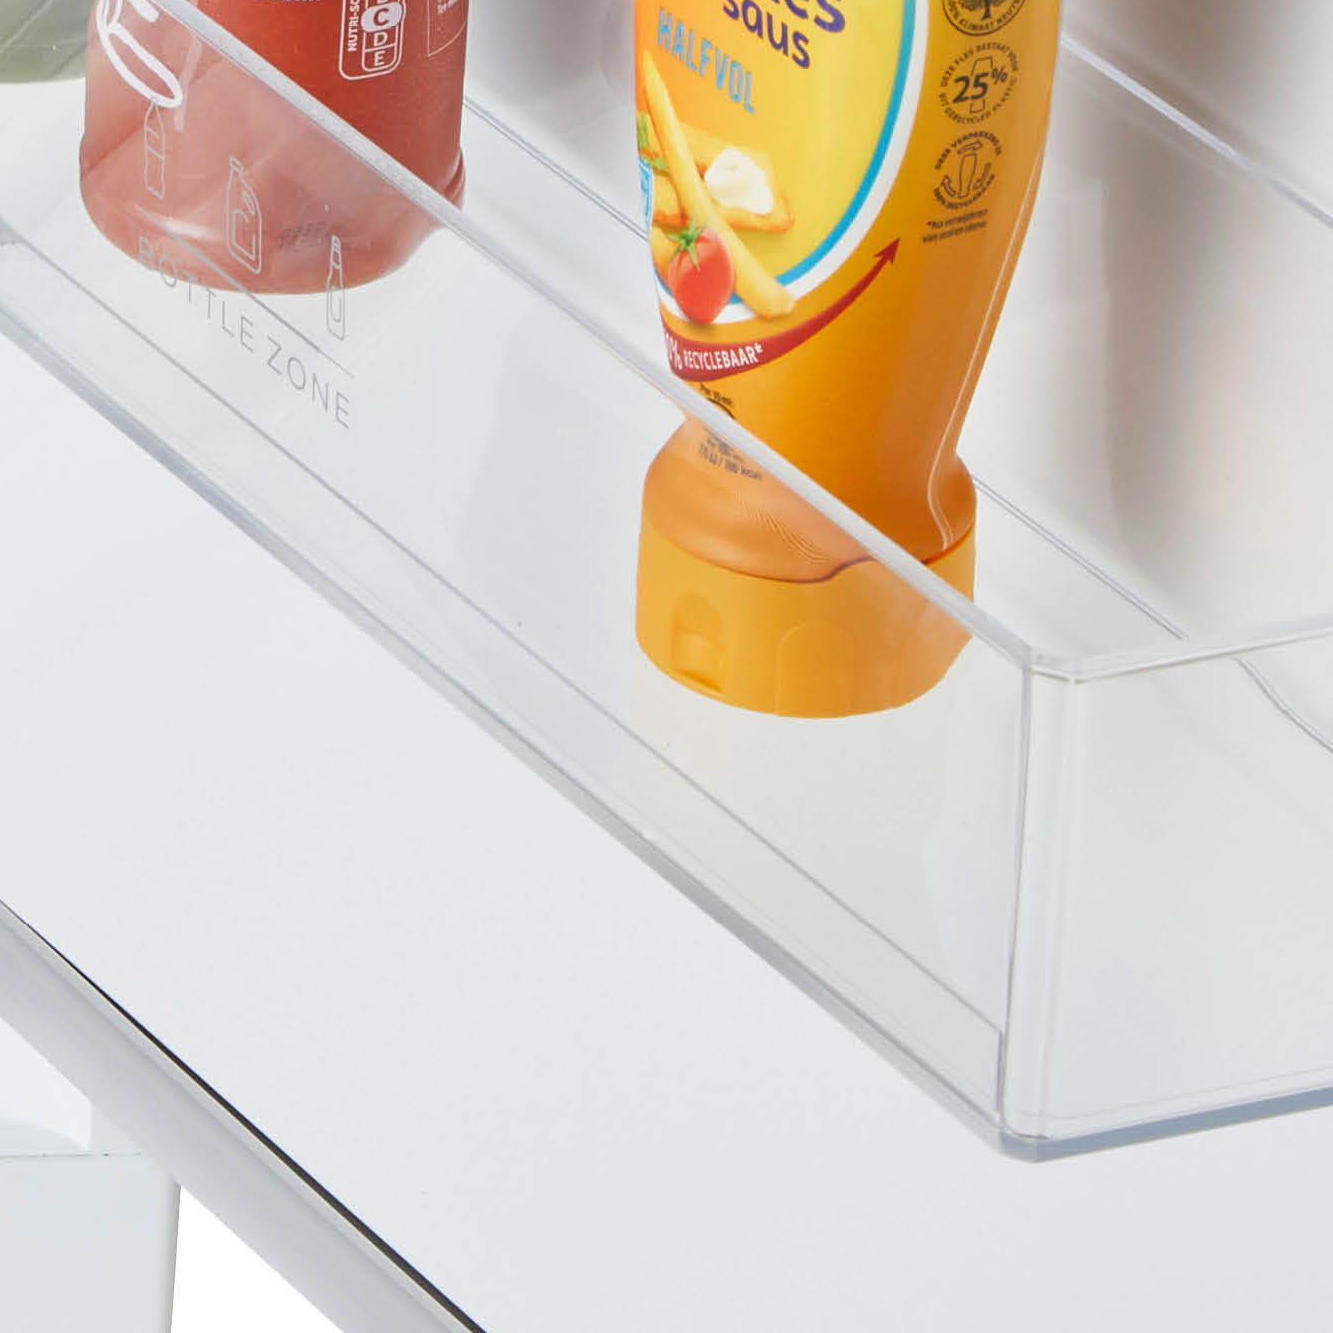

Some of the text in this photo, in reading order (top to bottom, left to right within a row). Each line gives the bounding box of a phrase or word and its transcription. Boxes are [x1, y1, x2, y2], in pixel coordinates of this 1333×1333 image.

[372, 7, 388, 27] C
[373, 31, 388, 47] D
[373, 50, 386, 67] E
[658, 7, 757, 116] HALFVOL
[952, 66, 1008, 104] 25%
[138, 236, 351, 430] BOTTLE ZONE
